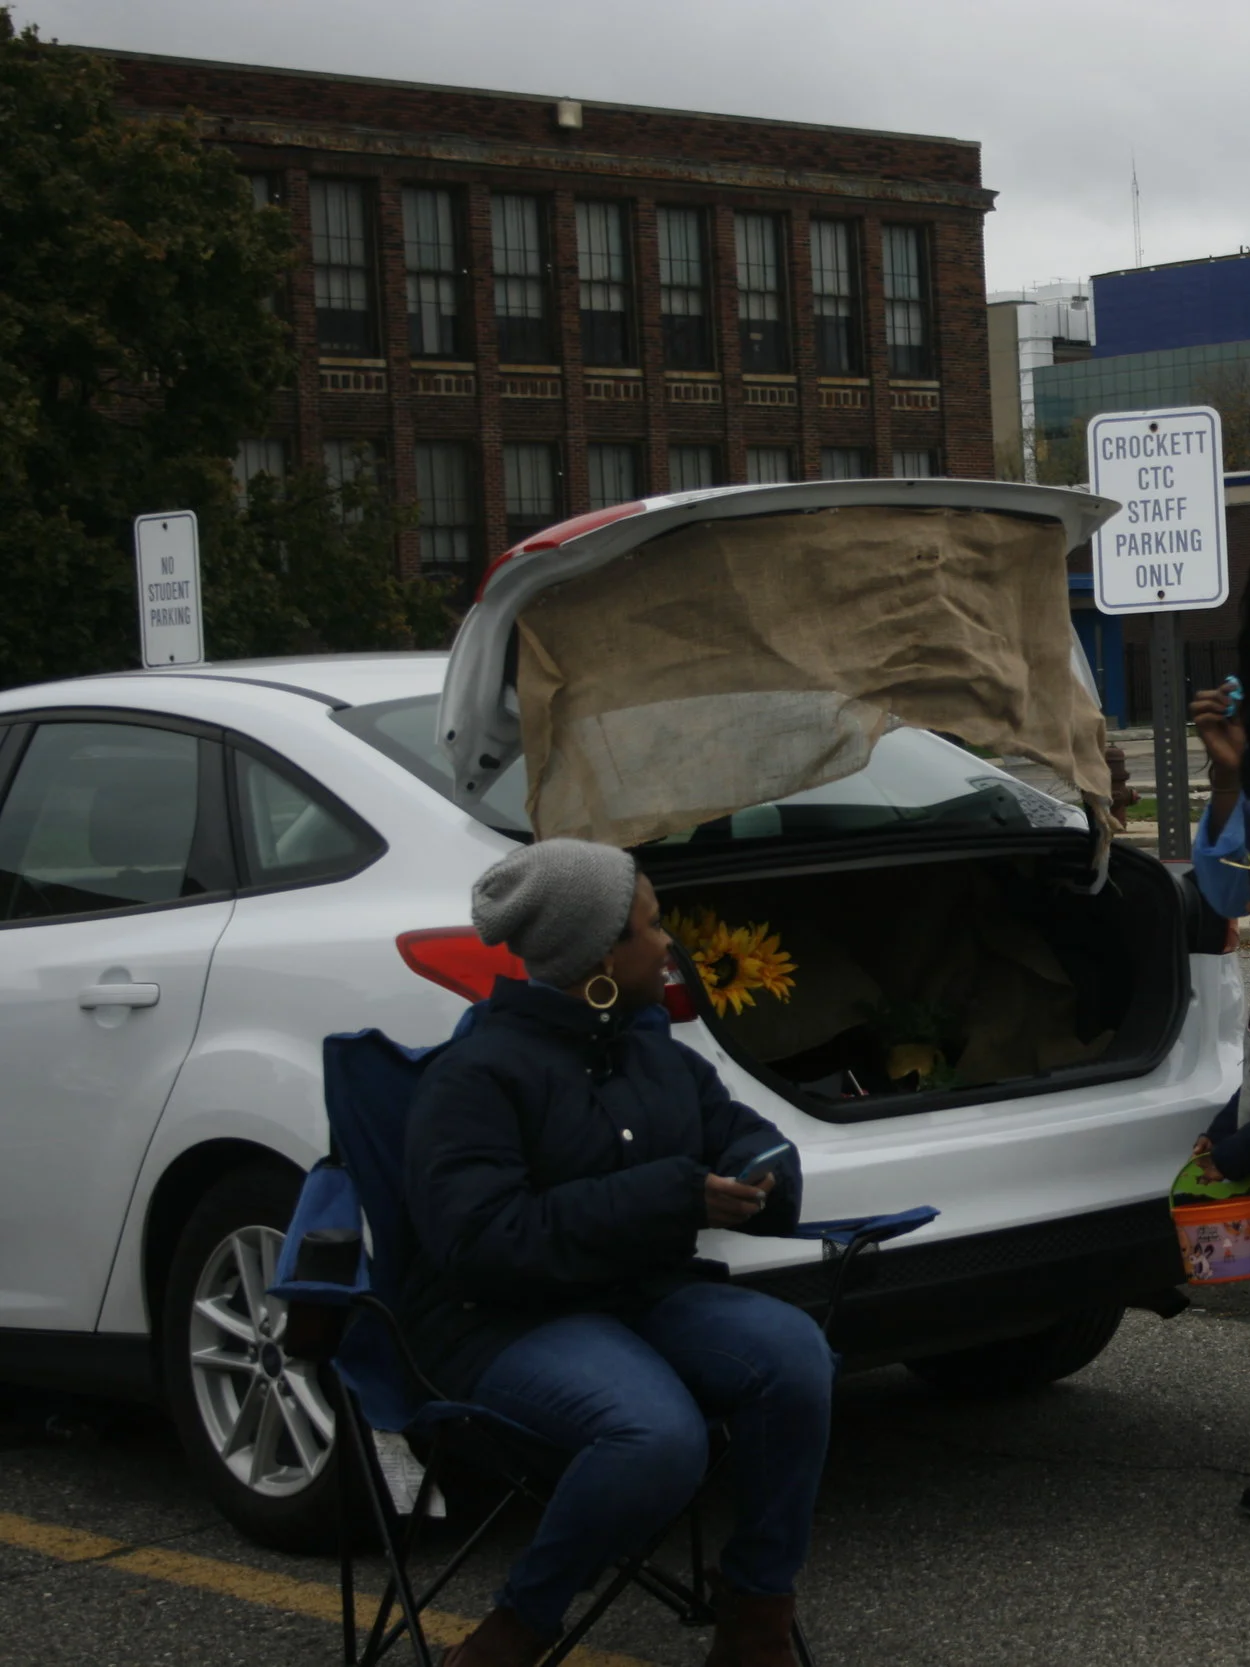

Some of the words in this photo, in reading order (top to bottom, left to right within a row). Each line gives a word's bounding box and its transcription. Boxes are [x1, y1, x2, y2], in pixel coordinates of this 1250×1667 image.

[1102, 431, 1208, 461] CROCKETT
[1138, 465, 1175, 490] CTC
[1128, 497, 1188, 524] STAFF
[1116, 529, 1203, 557] PARKING
[161, 556, 175, 575] NO
[1136, 562, 1185, 588] ONLY
[148, 580, 191, 602] STUDENT
[150, 606, 191, 627] PARKING
